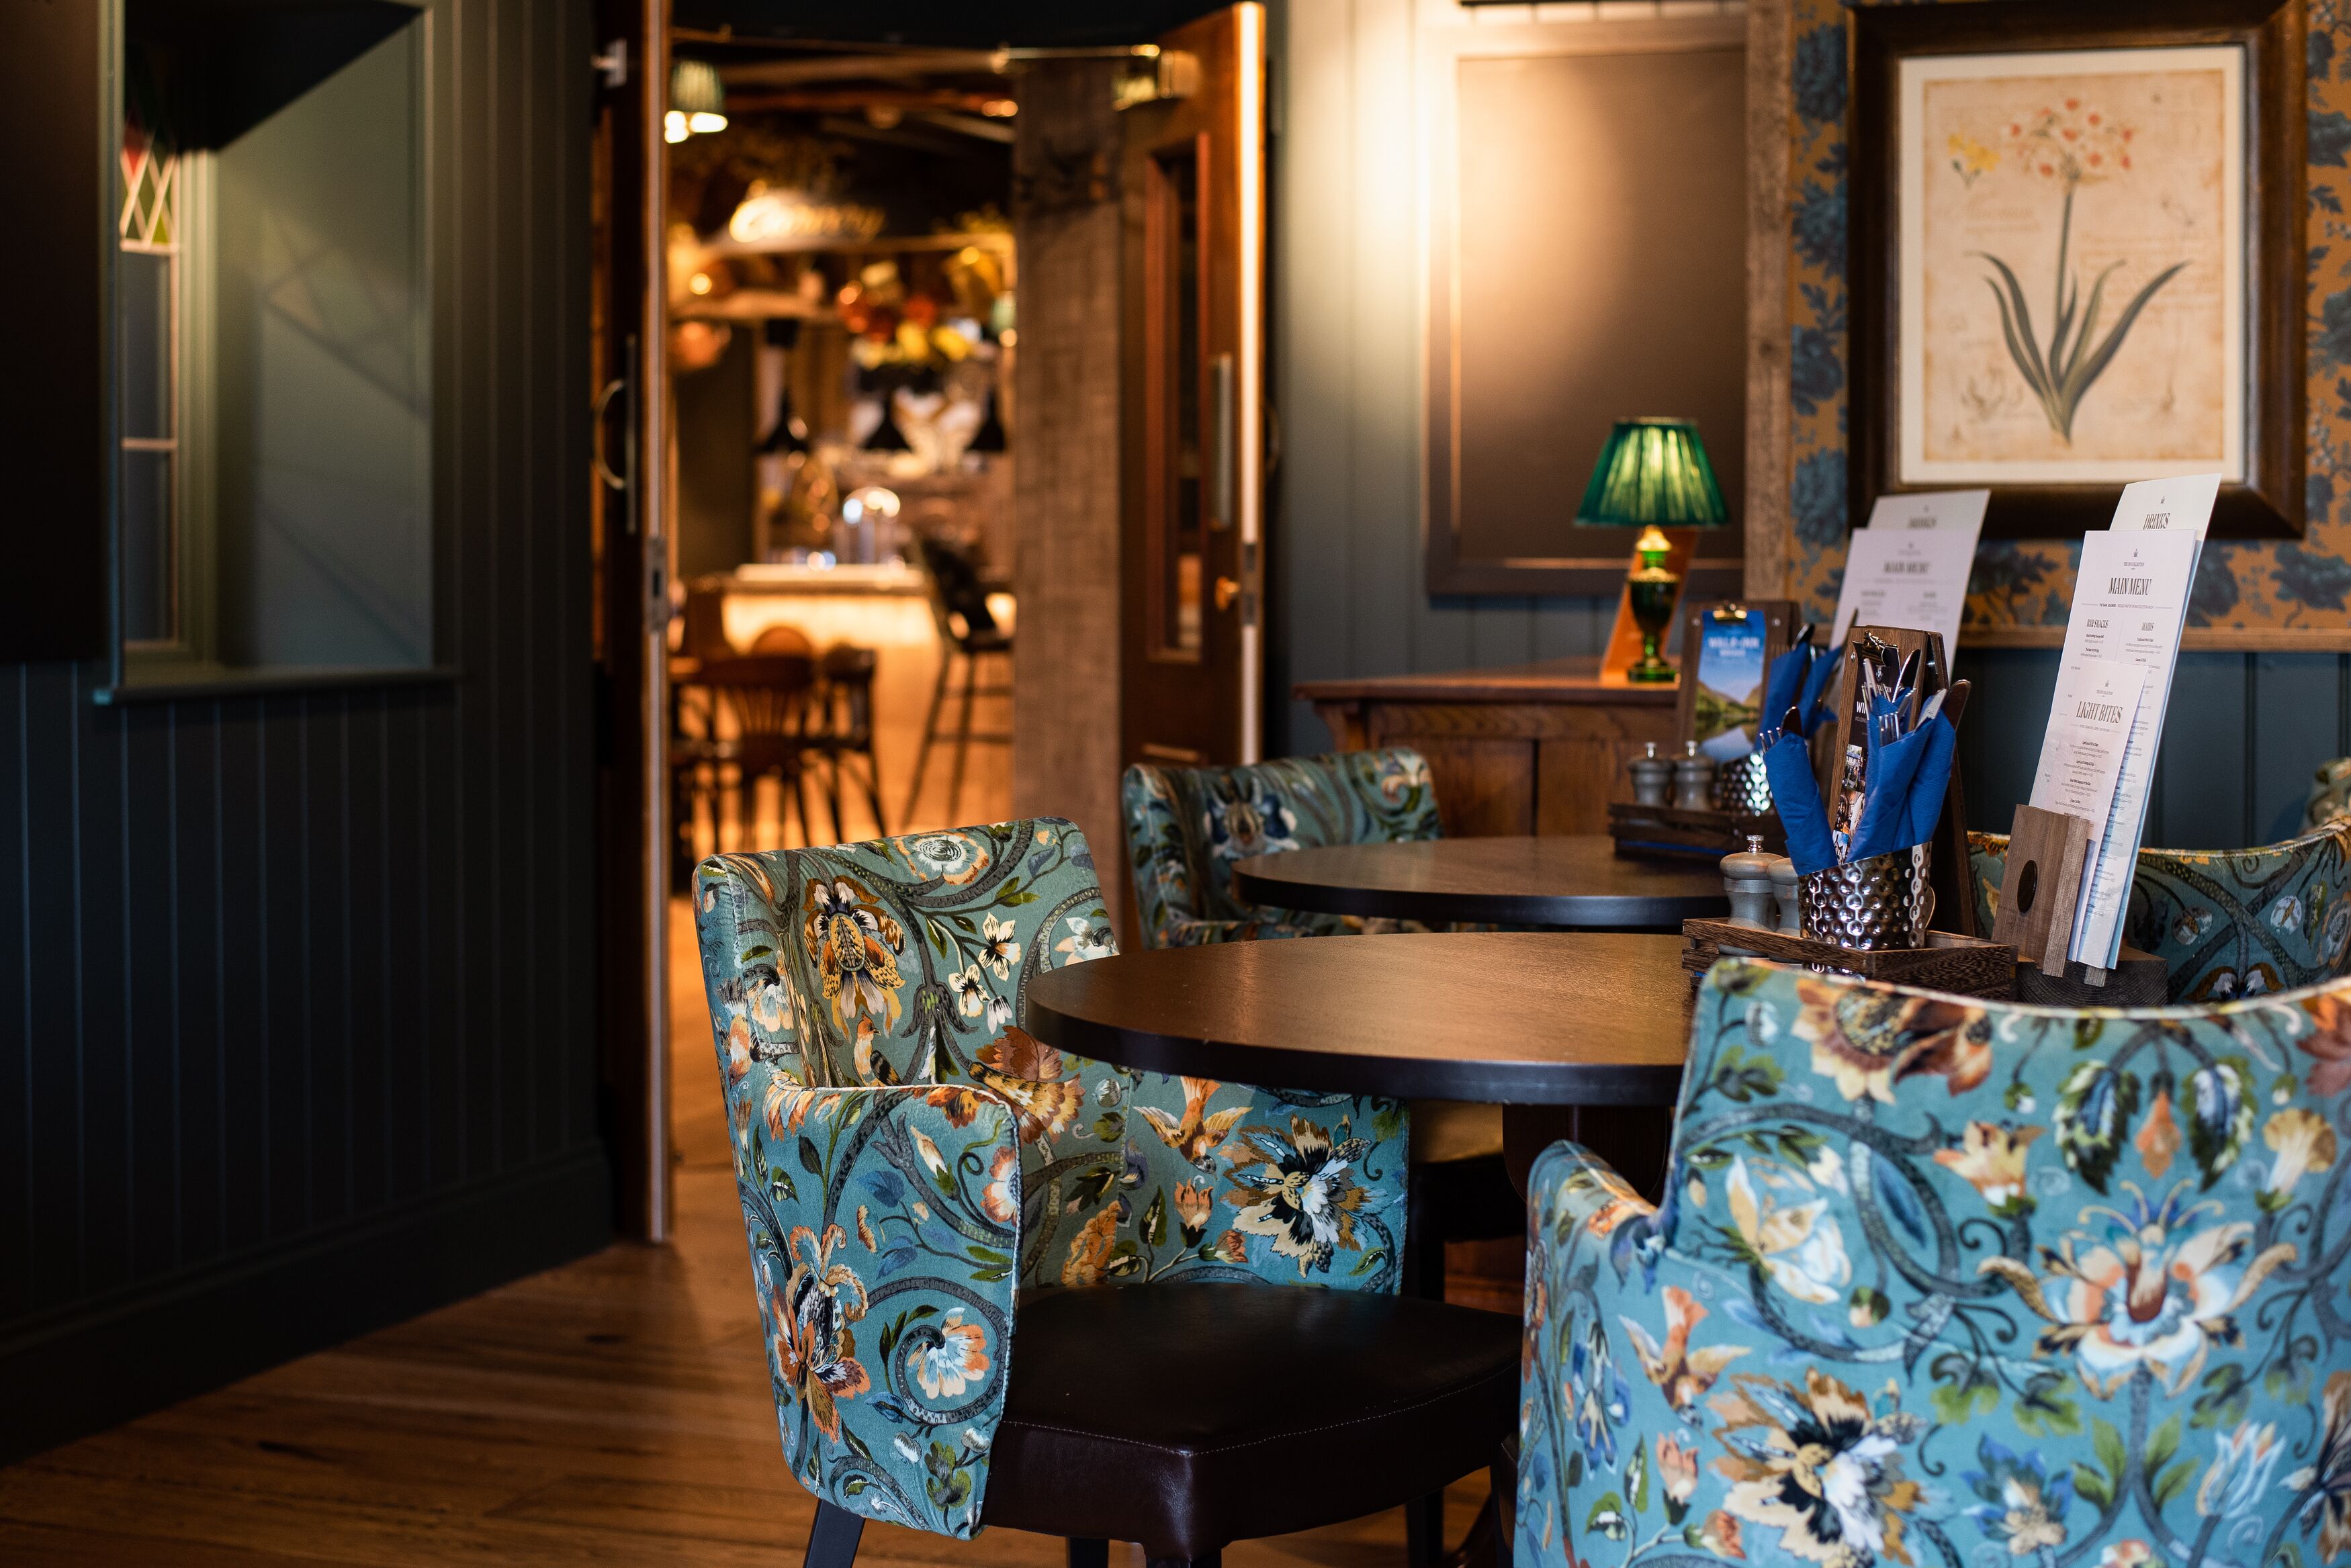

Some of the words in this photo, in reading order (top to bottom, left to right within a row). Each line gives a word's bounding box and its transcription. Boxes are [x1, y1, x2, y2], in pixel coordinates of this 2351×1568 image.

[2143, 512, 2170, 530] DRINKS
[2108, 578, 2129, 594] MAIN
[2127, 578, 2152, 596] MENU
[2086, 618, 2094, 627] BAR
[2094, 619, 2109, 629] SNACKS
[2076, 700, 2101, 721] LIGHT
[2098, 704, 2123, 724] BITES
